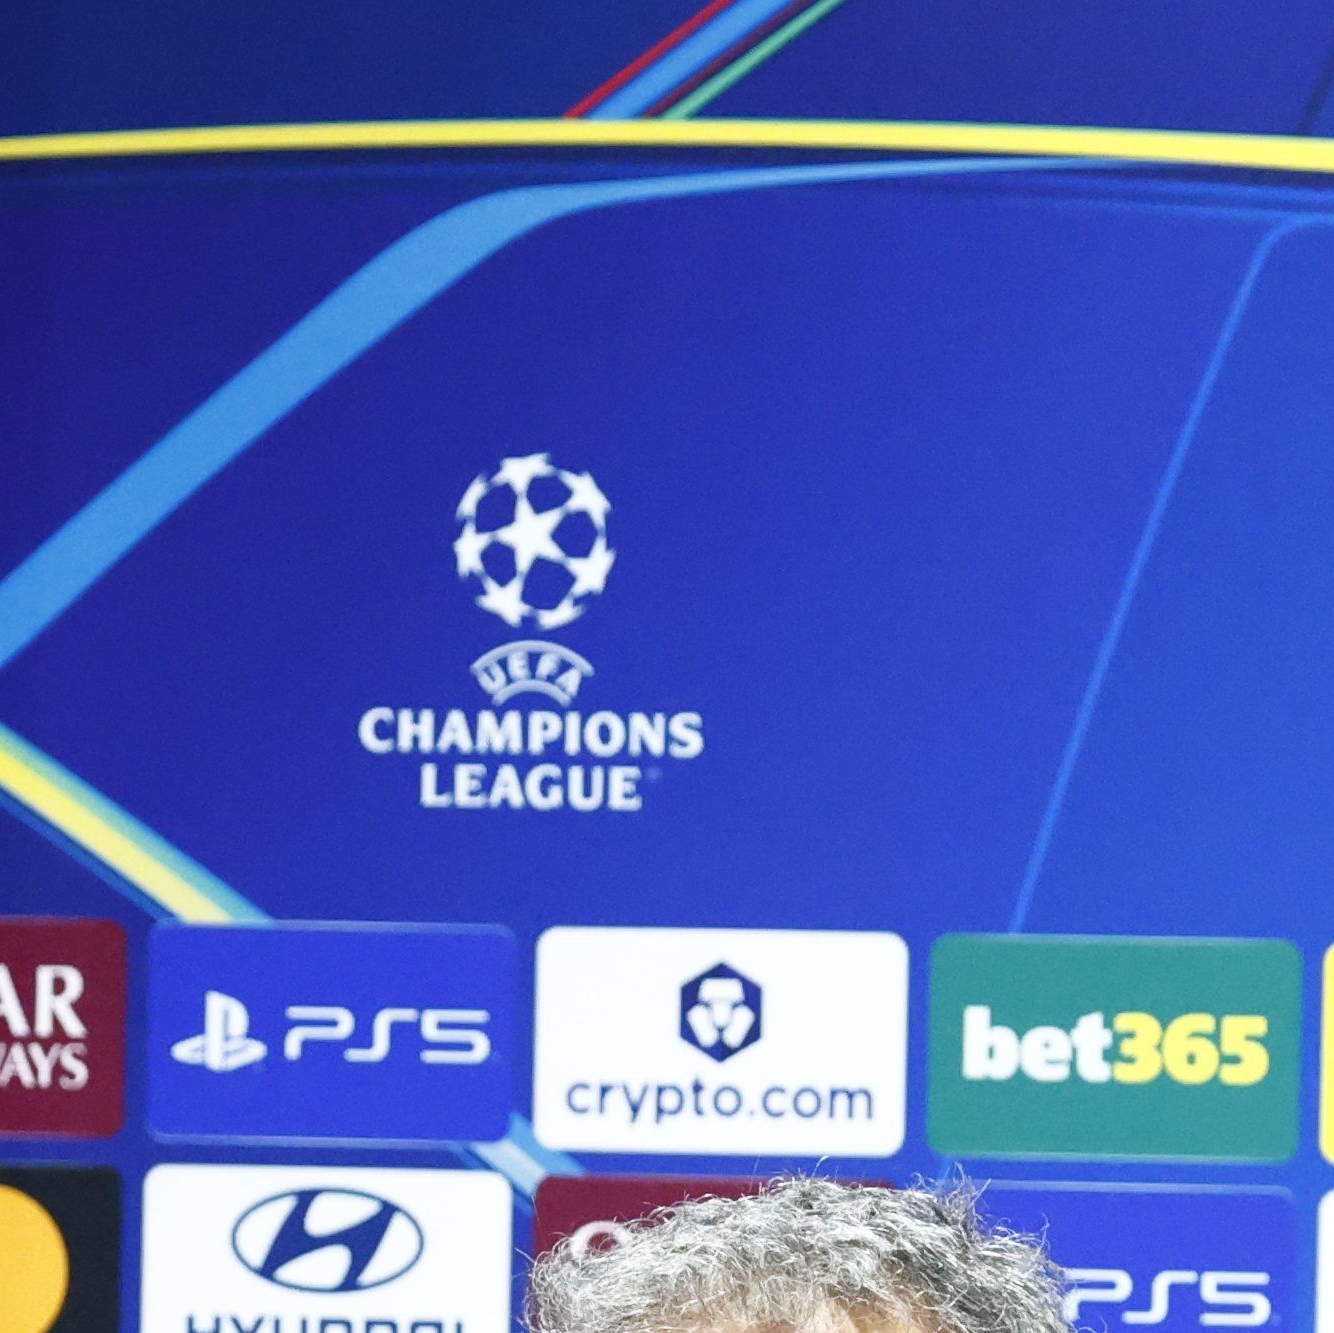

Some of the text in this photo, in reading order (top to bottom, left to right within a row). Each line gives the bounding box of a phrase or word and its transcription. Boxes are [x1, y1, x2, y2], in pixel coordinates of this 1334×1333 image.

[478, 651, 581, 694] UEFA
[359, 707, 704, 758] CHAMPIONS
[421, 763, 641, 811] LEAGUE
[285, 1006, 490, 1064] PS5
[962, 1005, 1269, 1086] bet365
[566, 1077, 873, 1124] crypto.com
[1064, 1269, 1273, 1326] PS5
